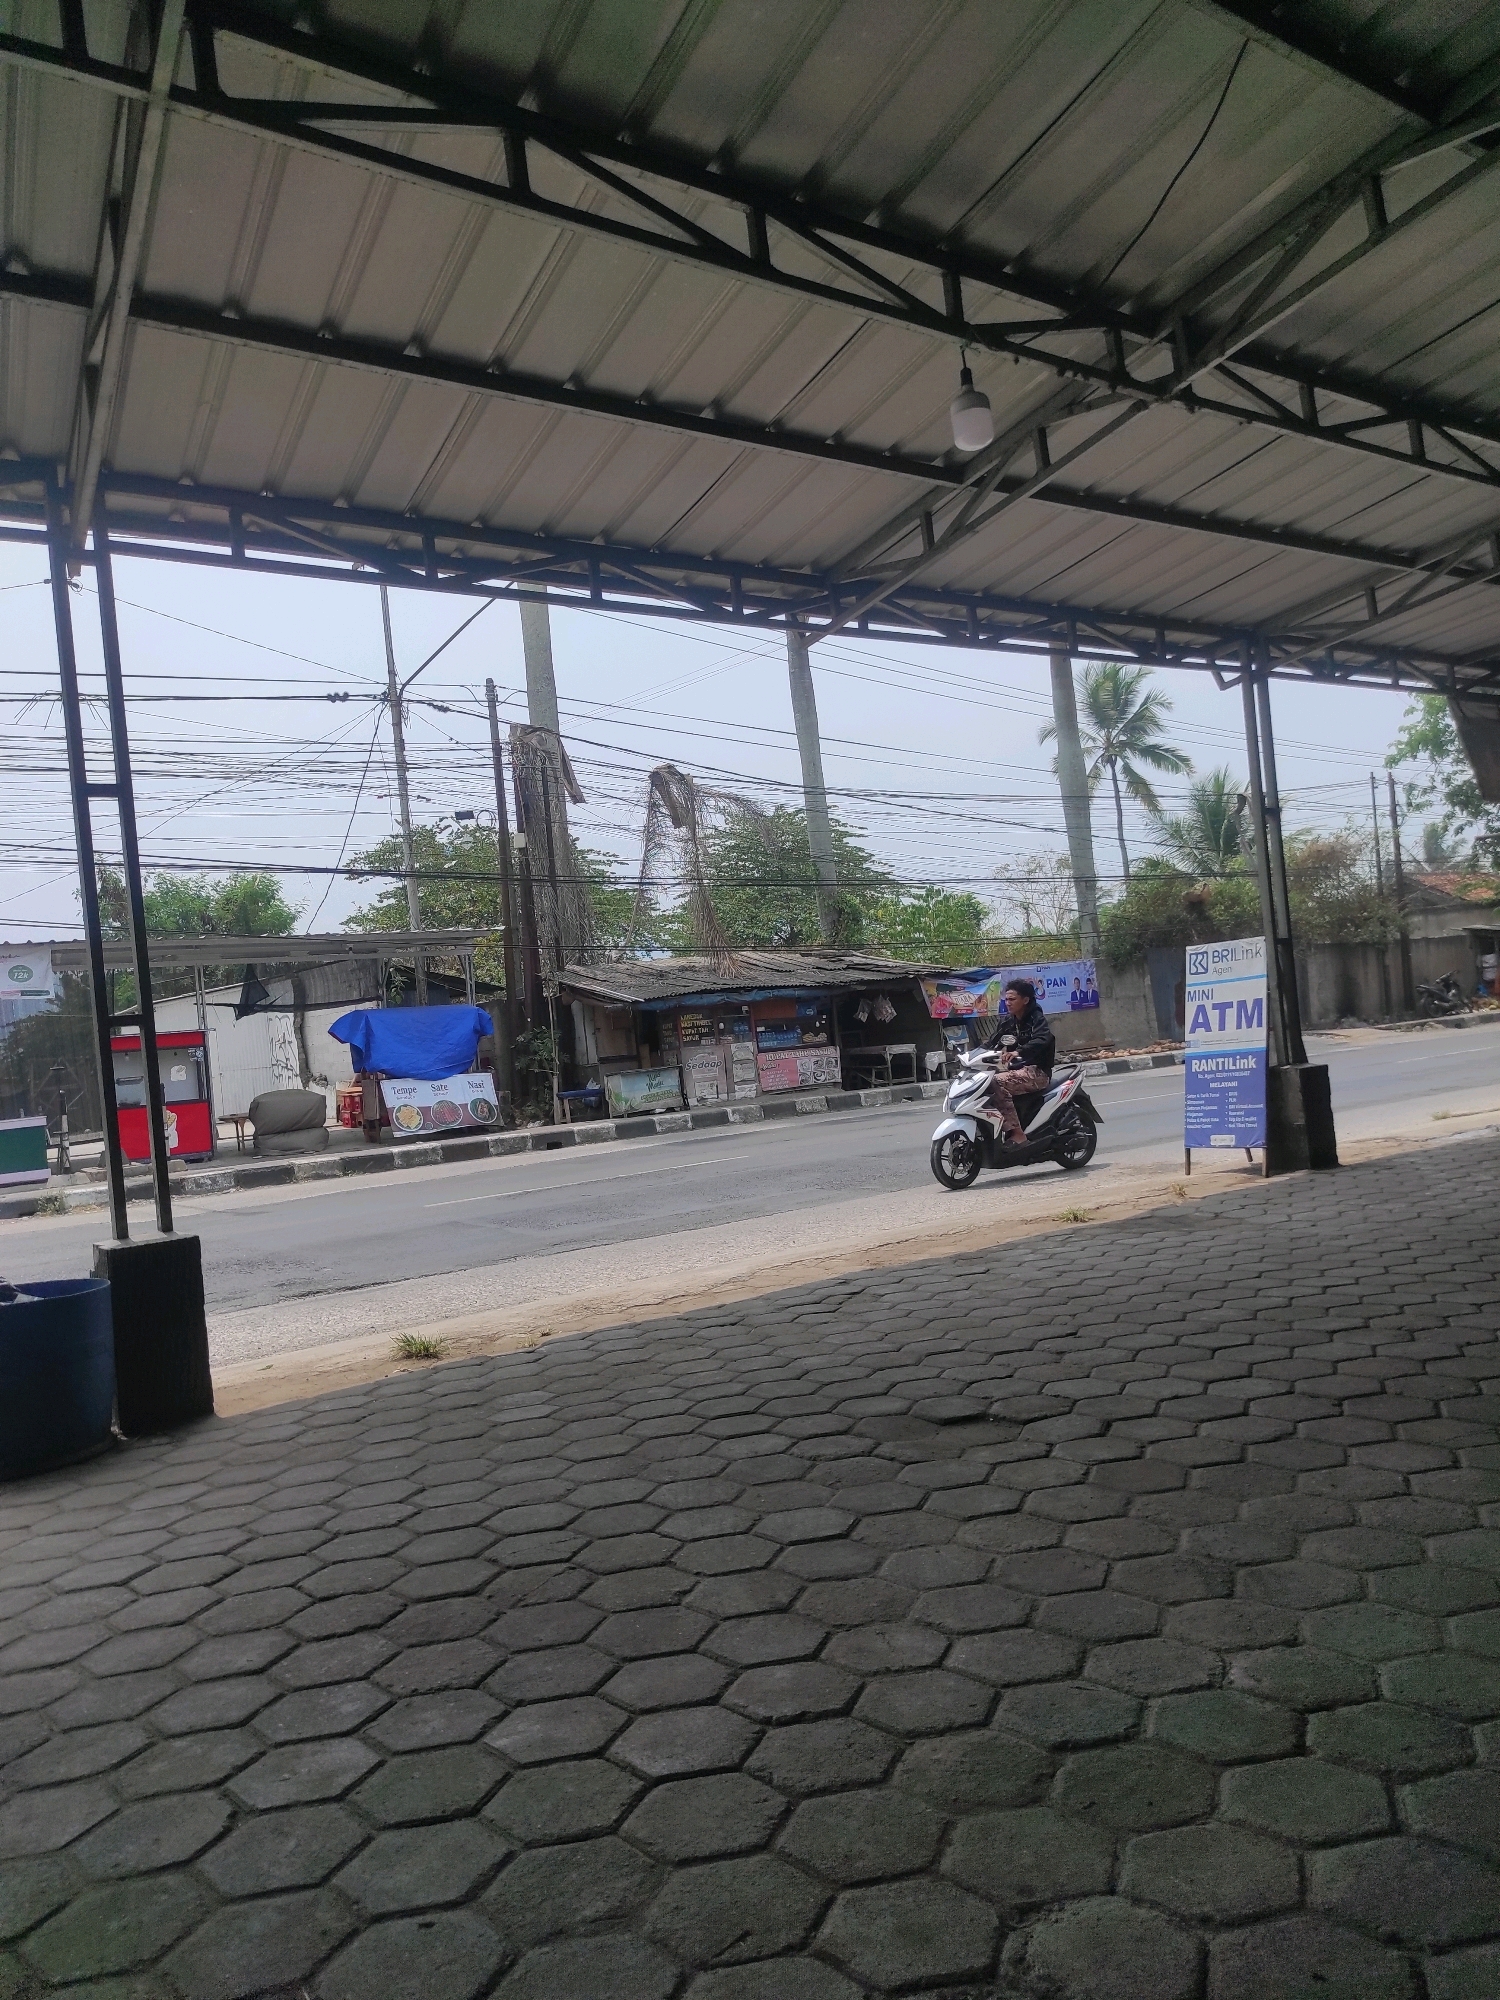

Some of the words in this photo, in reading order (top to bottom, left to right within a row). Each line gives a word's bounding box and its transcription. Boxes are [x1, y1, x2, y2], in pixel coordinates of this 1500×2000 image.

[1212, 943, 1262, 964] BRILink
[1212, 966, 1232, 976] Agen
[1046, 976, 1067, 989] PAN
[1187, 988, 1214, 1002] MINI
[1188, 998, 1263, 1034] ATM
[684, 1059, 723, 1071] Sedaap
[1192, 1055, 1256, 1072] RANTILink
[391, 1086, 418, 1095] Tempe
[430, 1083, 449, 1092] Sate
[467, 1080, 485, 1089] Nasi
